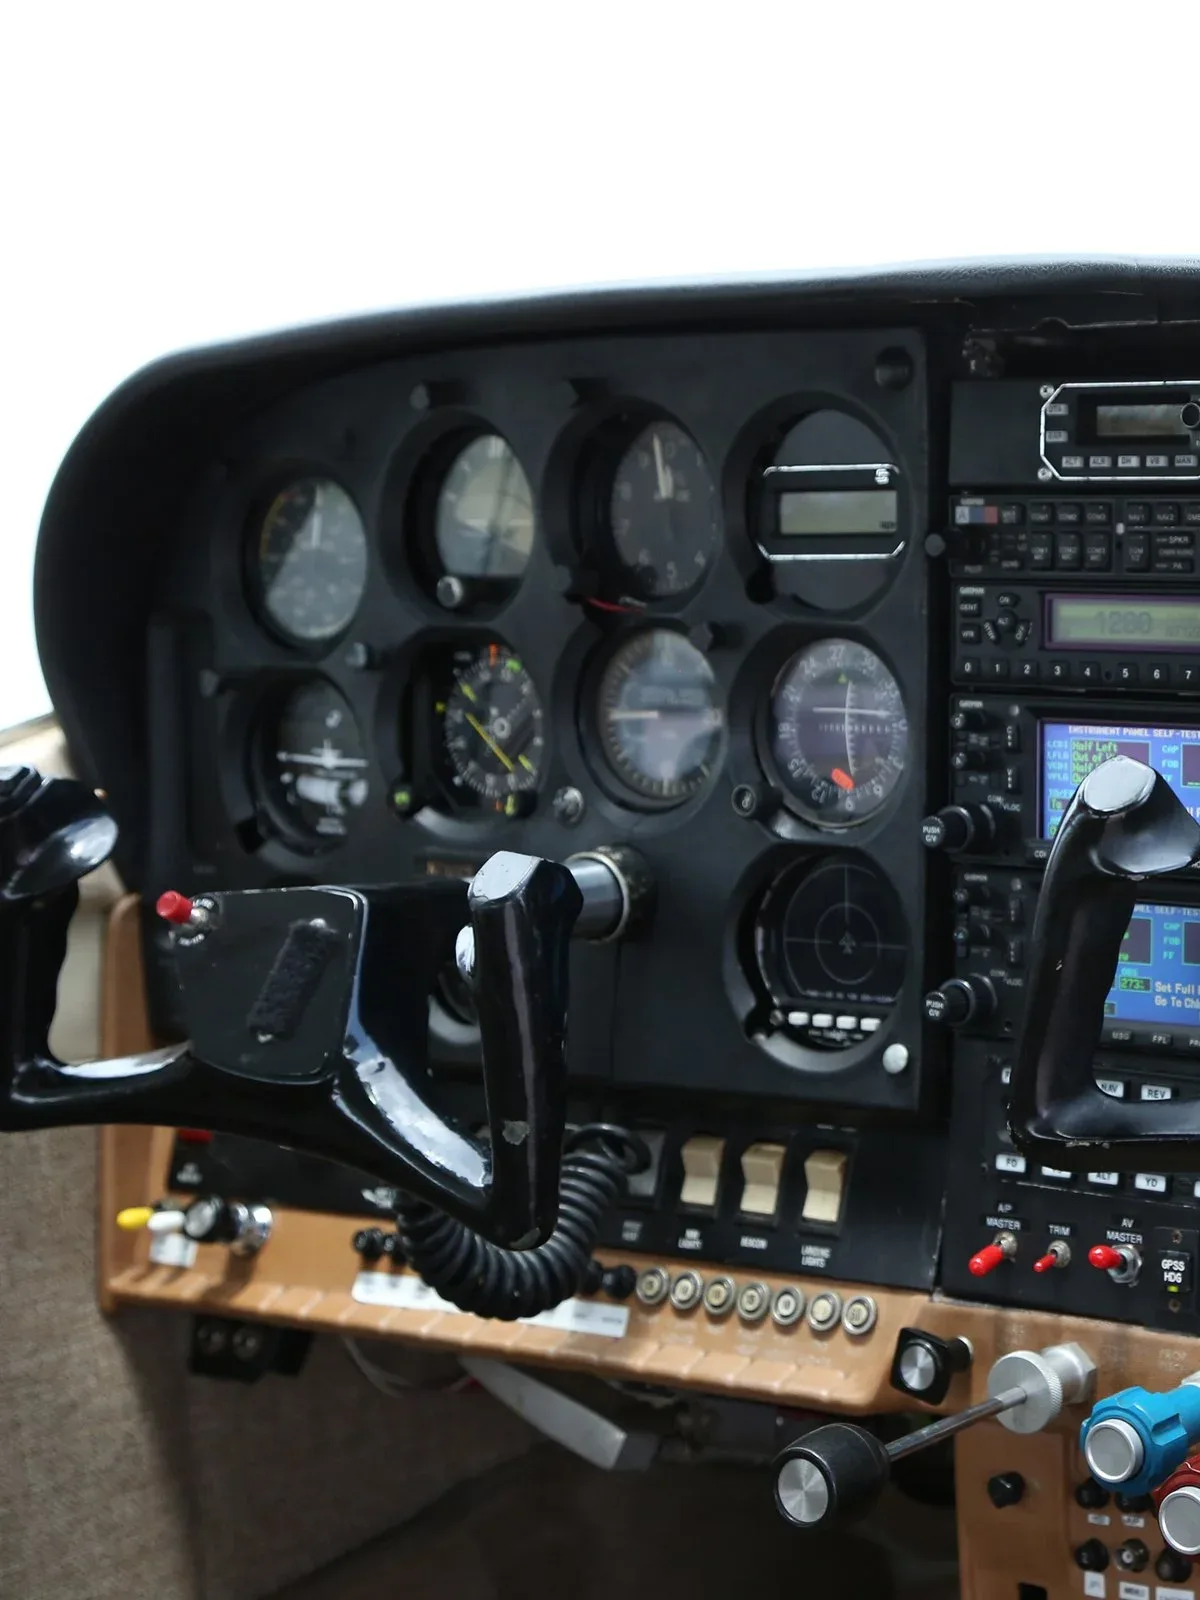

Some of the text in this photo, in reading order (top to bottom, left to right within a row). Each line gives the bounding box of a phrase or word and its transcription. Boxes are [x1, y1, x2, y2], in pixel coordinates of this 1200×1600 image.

[1122, 727, 1150, 738] PANEL
[1096, 740, 1118, 753] Left
[922, 825, 941, 834] PUSH
[1154, 981, 1172, 993] Set
[1175, 983, 1195, 995] Full
[1171, 996, 1182, 1008] To
[1152, 1035, 1168, 1045] FPL
[1147, 1089, 1166, 1099] REV
[1146, 1178, 1158, 1188] YD
[997, 1203, 1013, 1214] AP
[986, 1217, 1022, 1231] MASTER
[1121, 1218, 1135, 1229] AV
[1048, 1225, 1071, 1237] TRIM
[1106, 1230, 1144, 1245] MASTER
[801, 1256, 826, 1268] LIGHTS
[1161, 1259, 1186, 1271] GPSS
[1163, 1271, 1183, 1283] HDG
